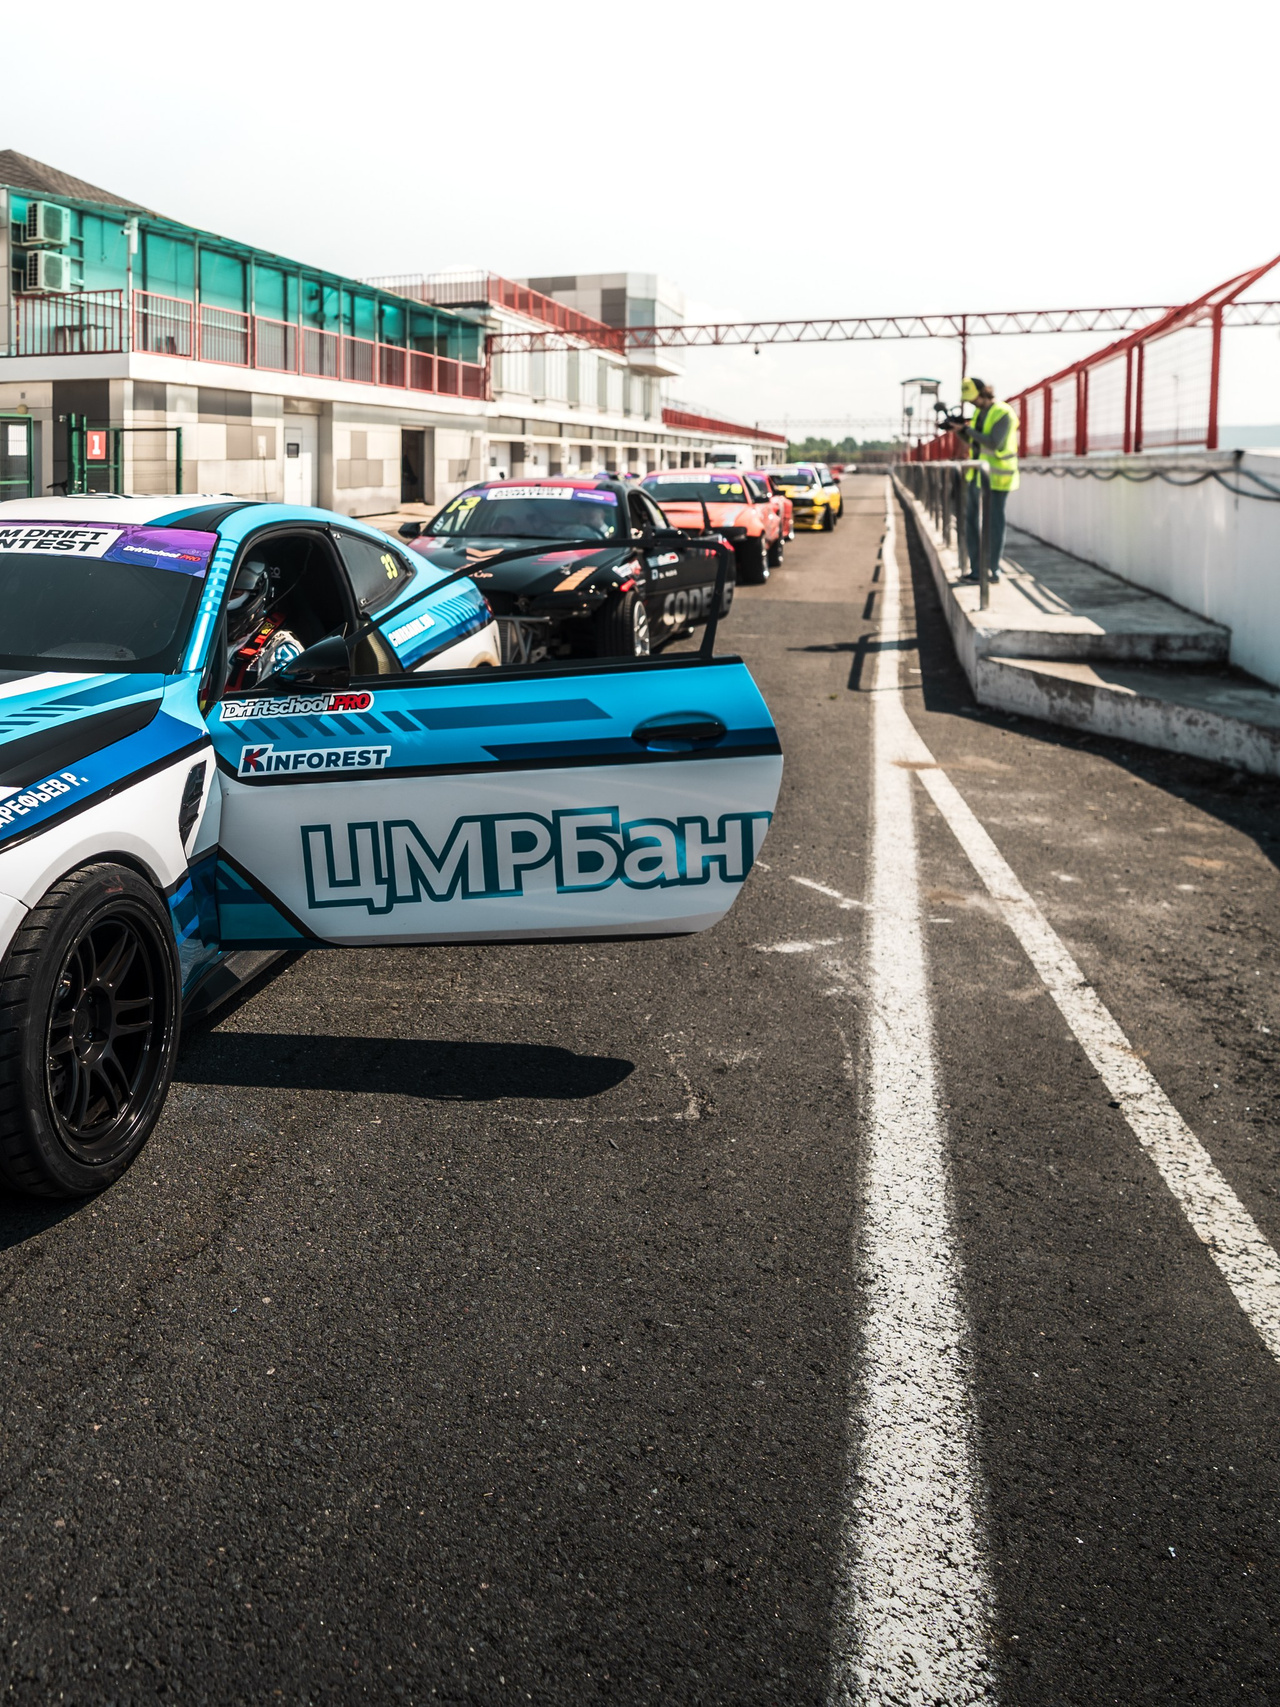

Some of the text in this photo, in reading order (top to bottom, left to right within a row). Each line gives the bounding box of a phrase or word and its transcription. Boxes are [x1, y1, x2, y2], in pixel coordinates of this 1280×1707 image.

[92, 435, 101, 455] 1
[446, 496, 482, 513] 13
[24, 529, 108, 541] DRIFT
[380, 553, 398, 580] 33
[241, 747, 388, 774] KINFOREST
